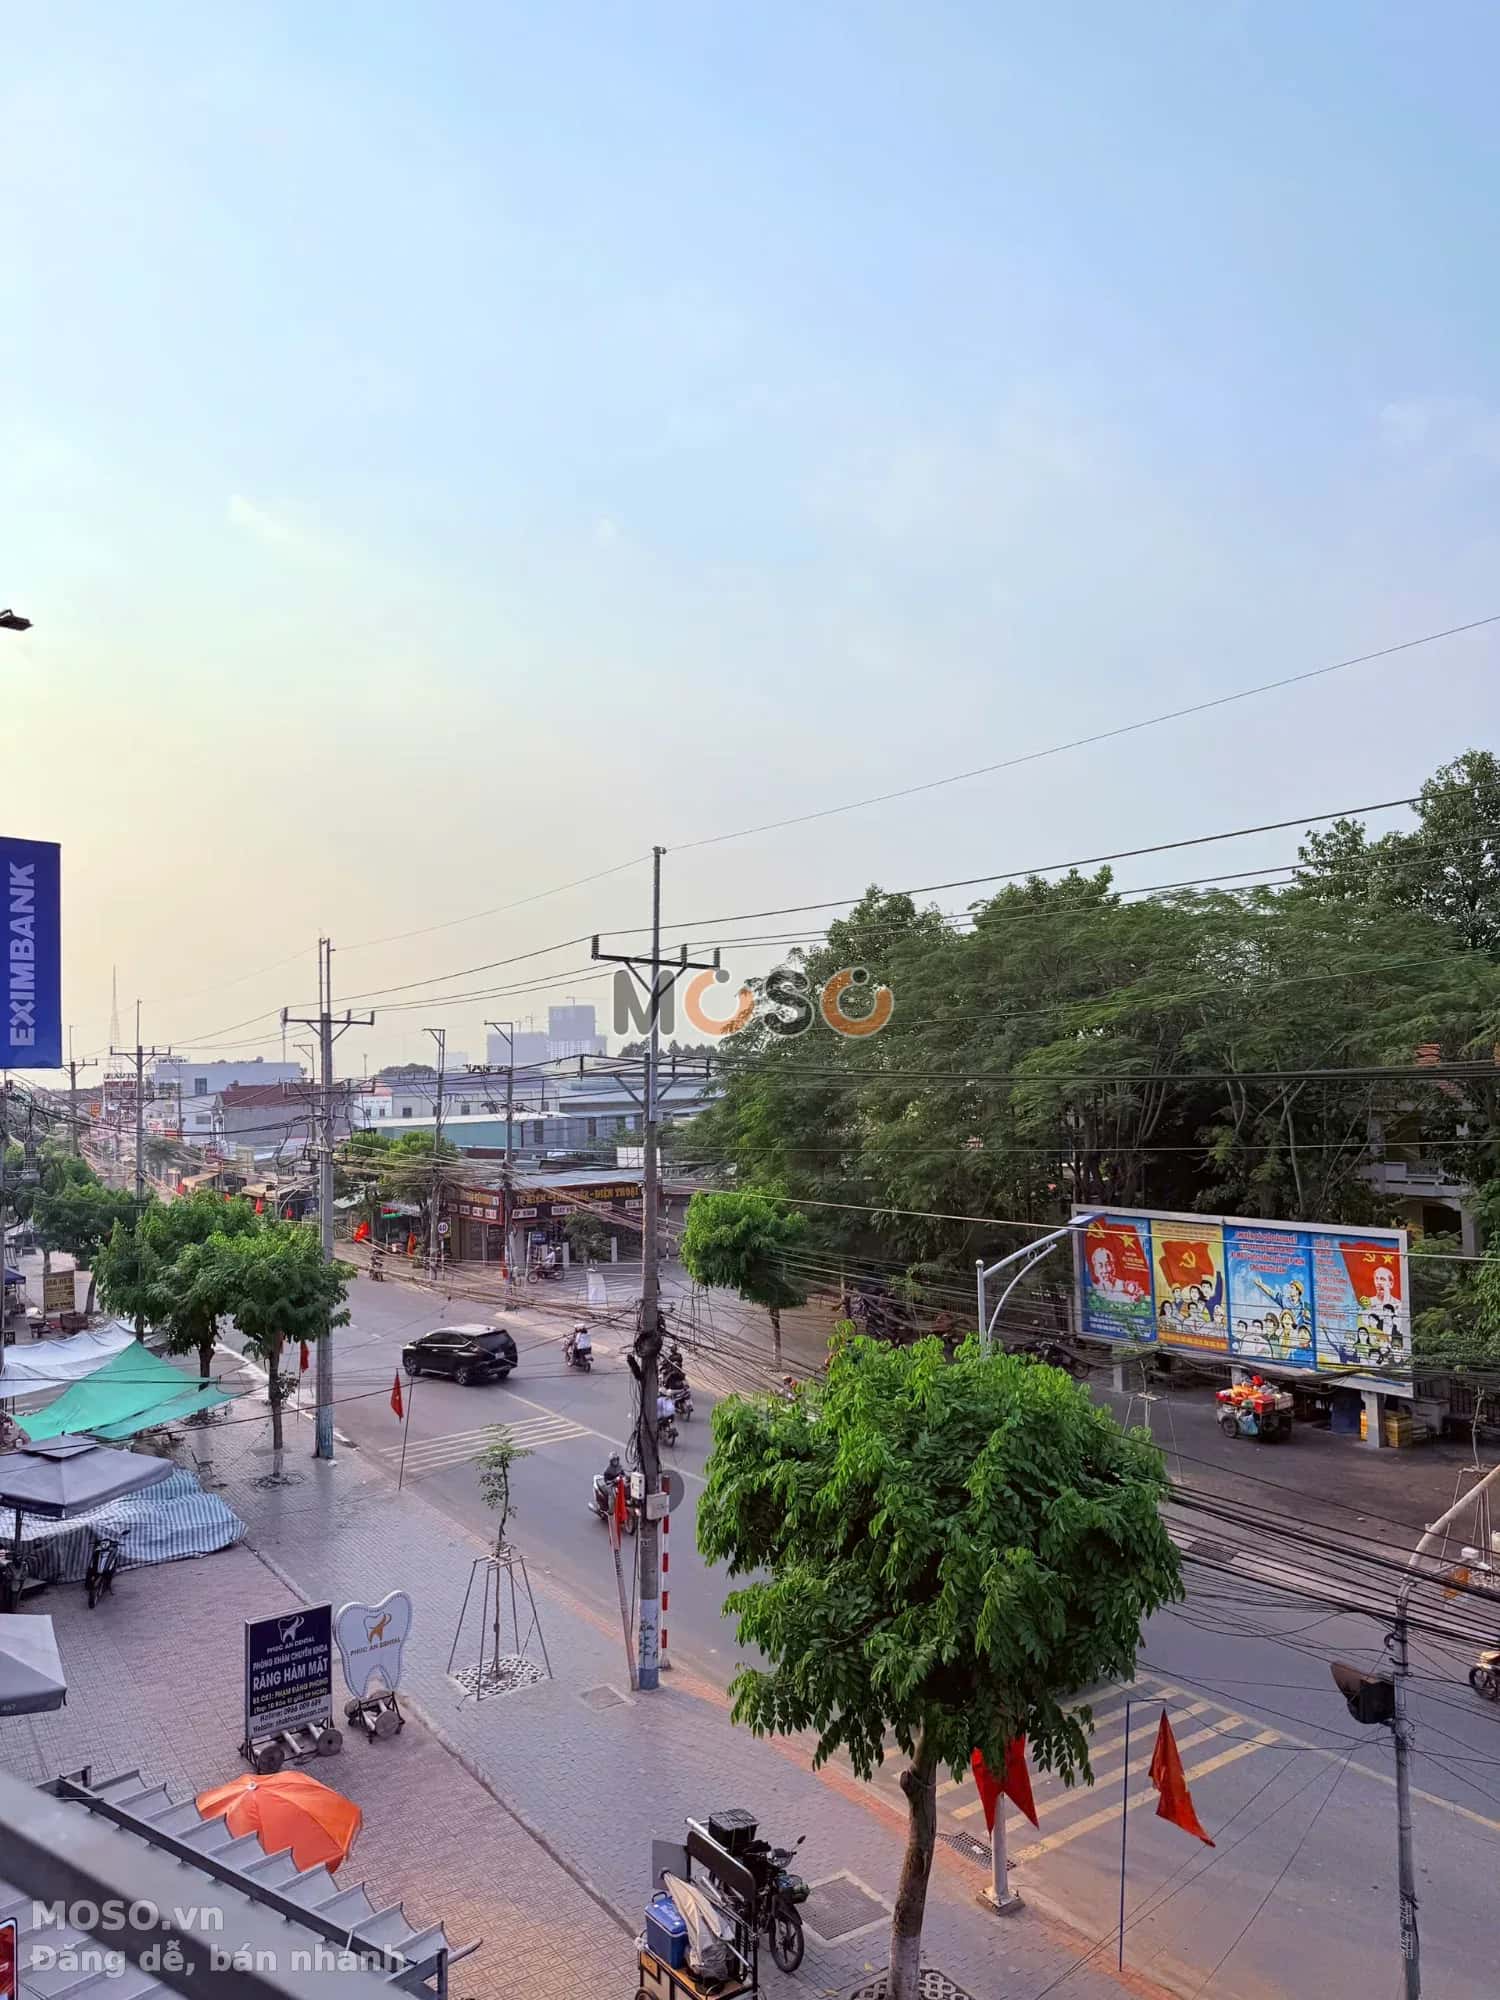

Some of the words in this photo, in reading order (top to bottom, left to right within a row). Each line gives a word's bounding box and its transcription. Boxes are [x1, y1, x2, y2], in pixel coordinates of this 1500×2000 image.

[9, 861, 35, 1046] EXIMBANK
[285, 1642, 294, 1650] AN
[294, 1635, 315, 1647] DENTAL
[379, 1635, 400, 1648] DENTAL
[252, 1657, 273, 1671] PHÒNG
[290, 1646, 312, 1661] CHUYÊN
[312, 1643, 328, 1655] KHOA
[253, 1671, 282, 1691] RĂNG
[284, 1663, 306, 1684] HÀM
[308, 1655, 328, 1677] MẶT
[275, 1687, 291, 1698] PHẠM
